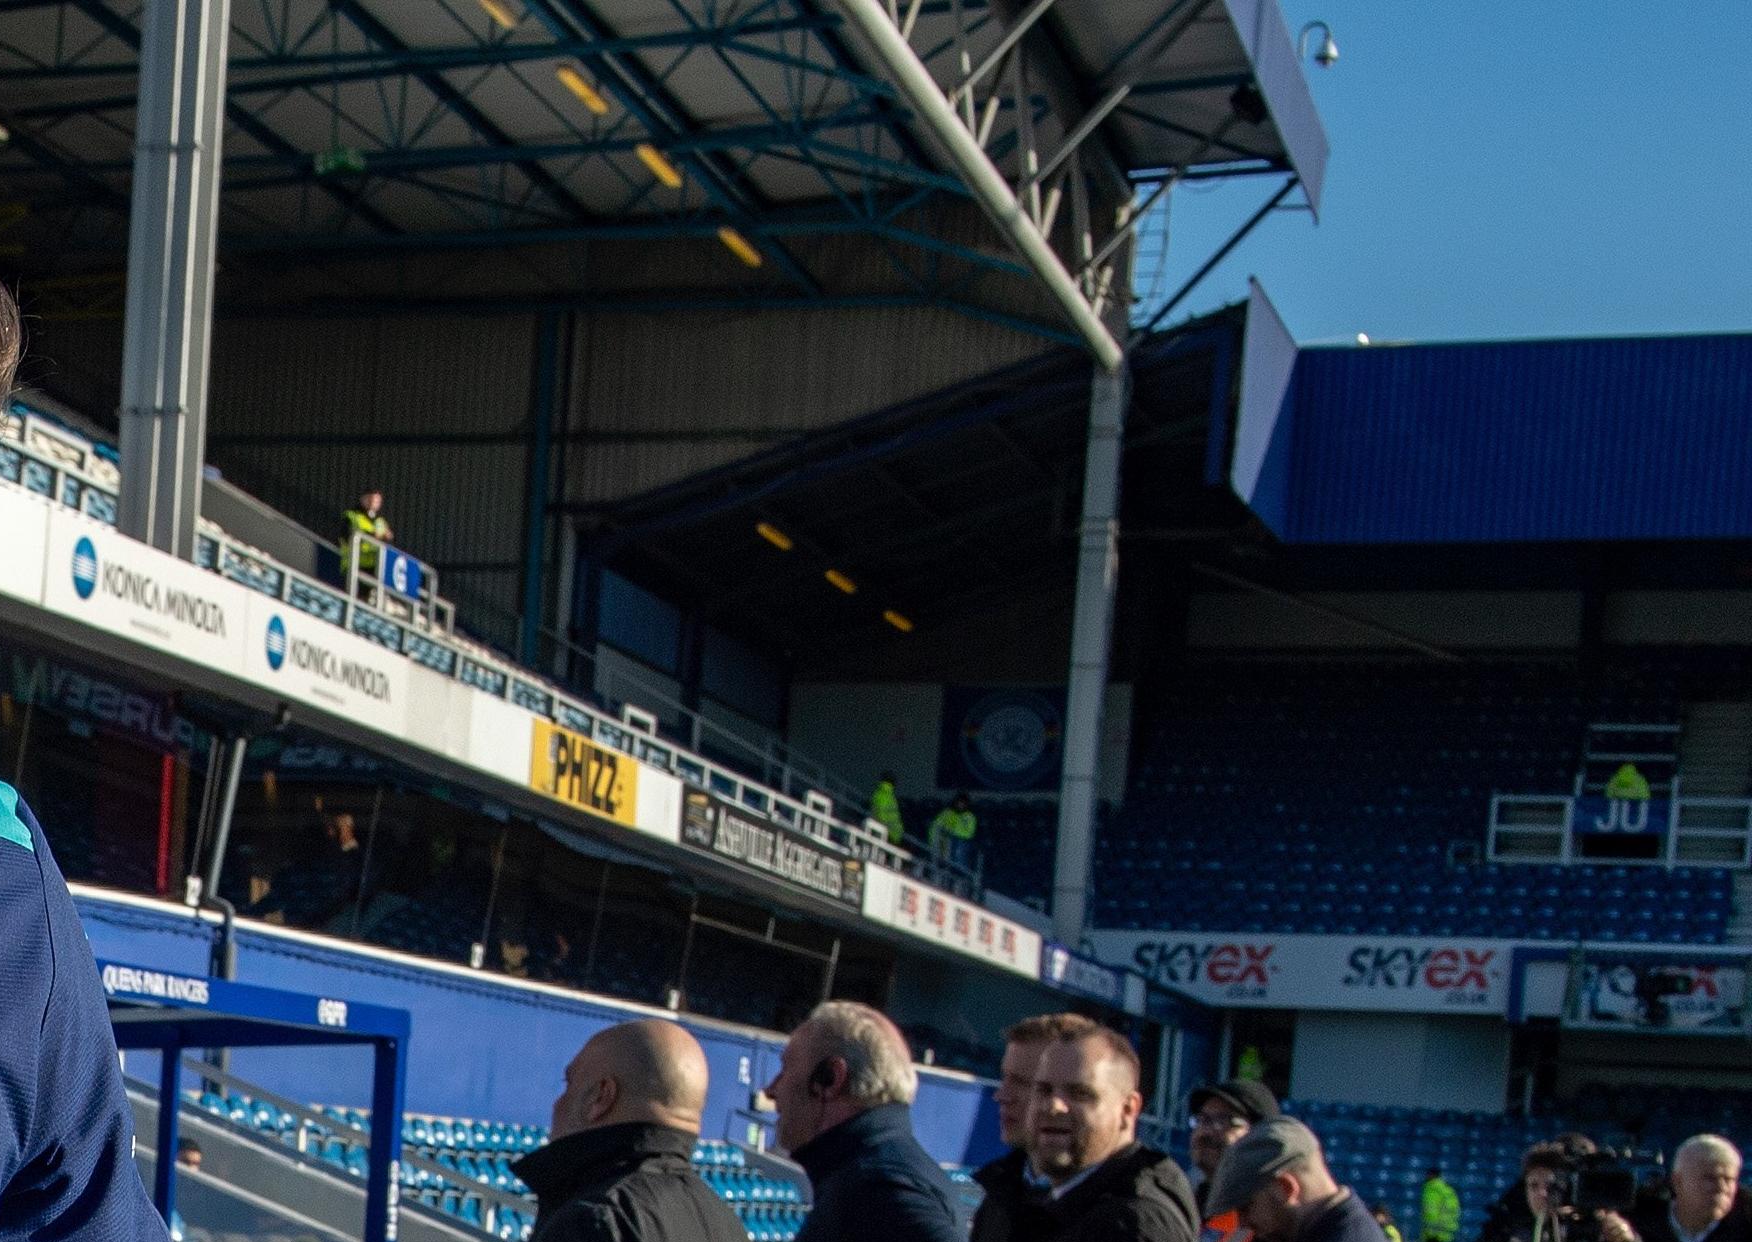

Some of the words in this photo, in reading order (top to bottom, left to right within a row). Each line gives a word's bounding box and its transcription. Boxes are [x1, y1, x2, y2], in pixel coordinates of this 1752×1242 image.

[103, 560, 162, 614] KONICA
[163, 586, 227, 639] MINOLTA
[552, 731, 618, 815] PHIZZ
